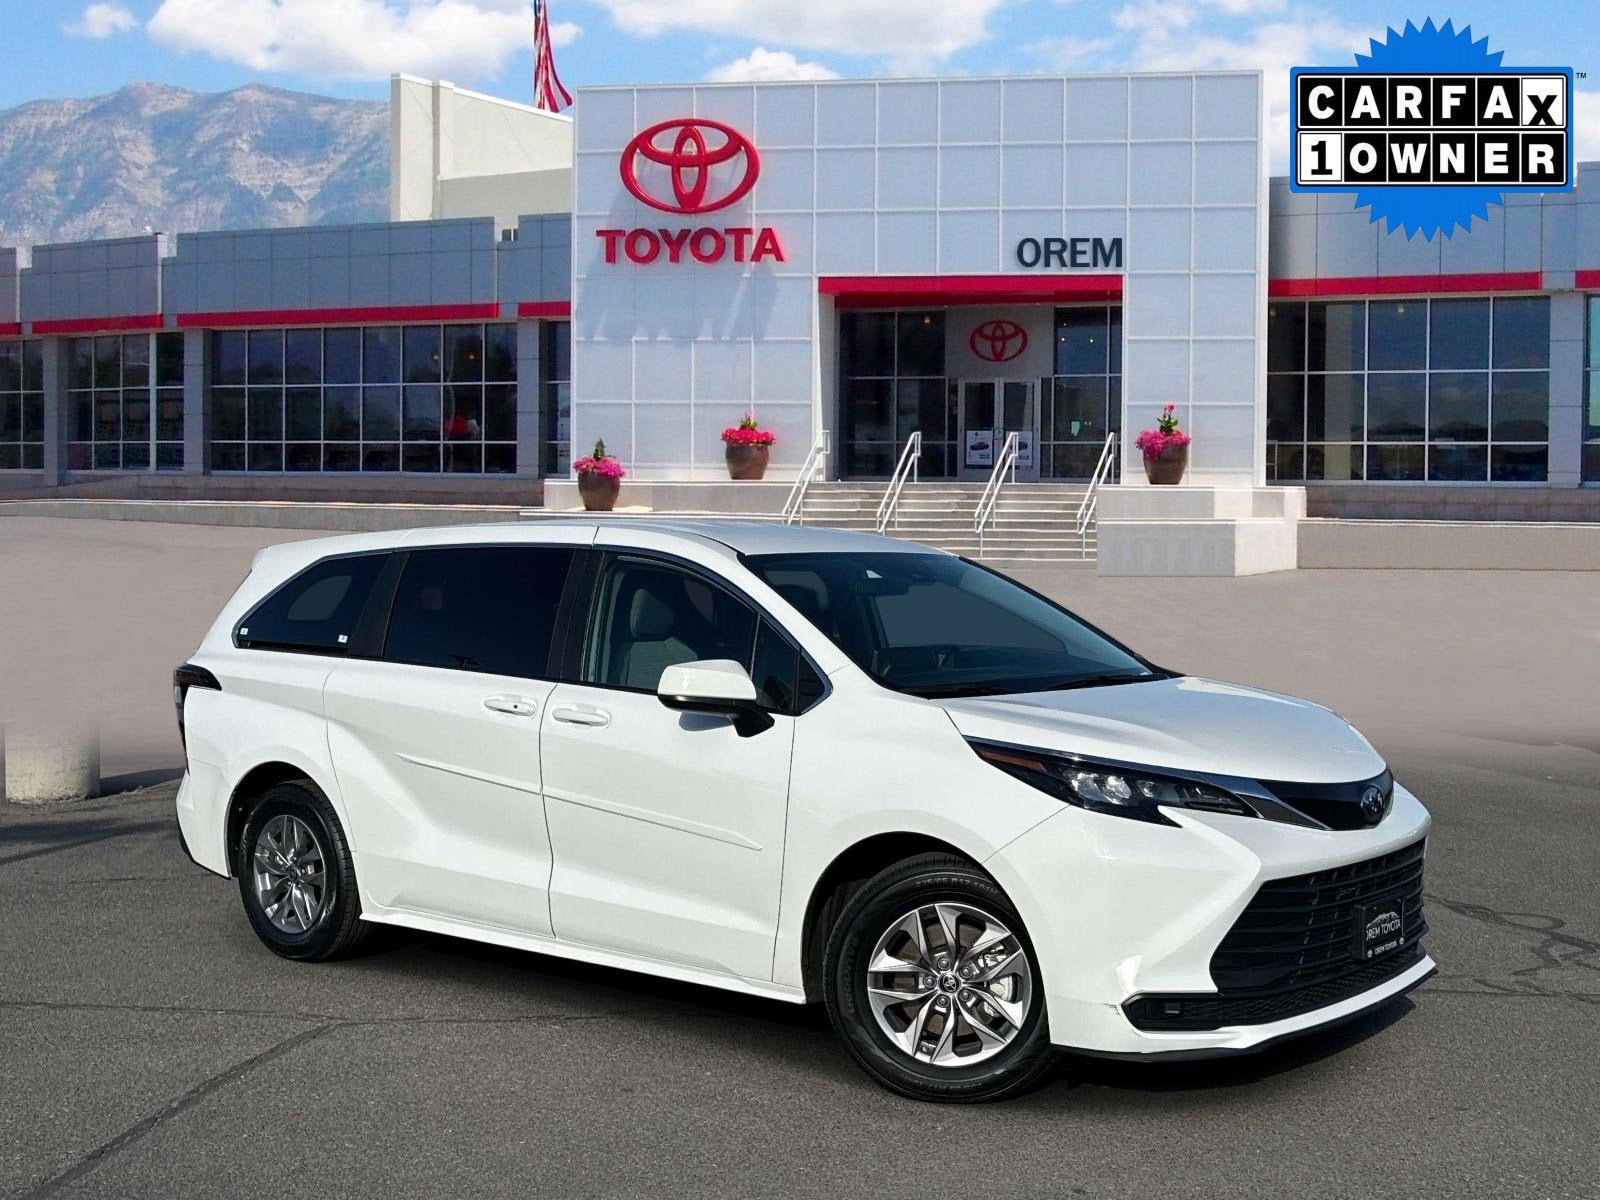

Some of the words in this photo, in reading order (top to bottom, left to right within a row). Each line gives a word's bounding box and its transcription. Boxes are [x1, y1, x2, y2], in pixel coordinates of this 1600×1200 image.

[596, 228, 785, 264] TOYOTA
[1016, 237, 1123, 269] OREM
[1381, 918, 1401, 935] TOYOTA
